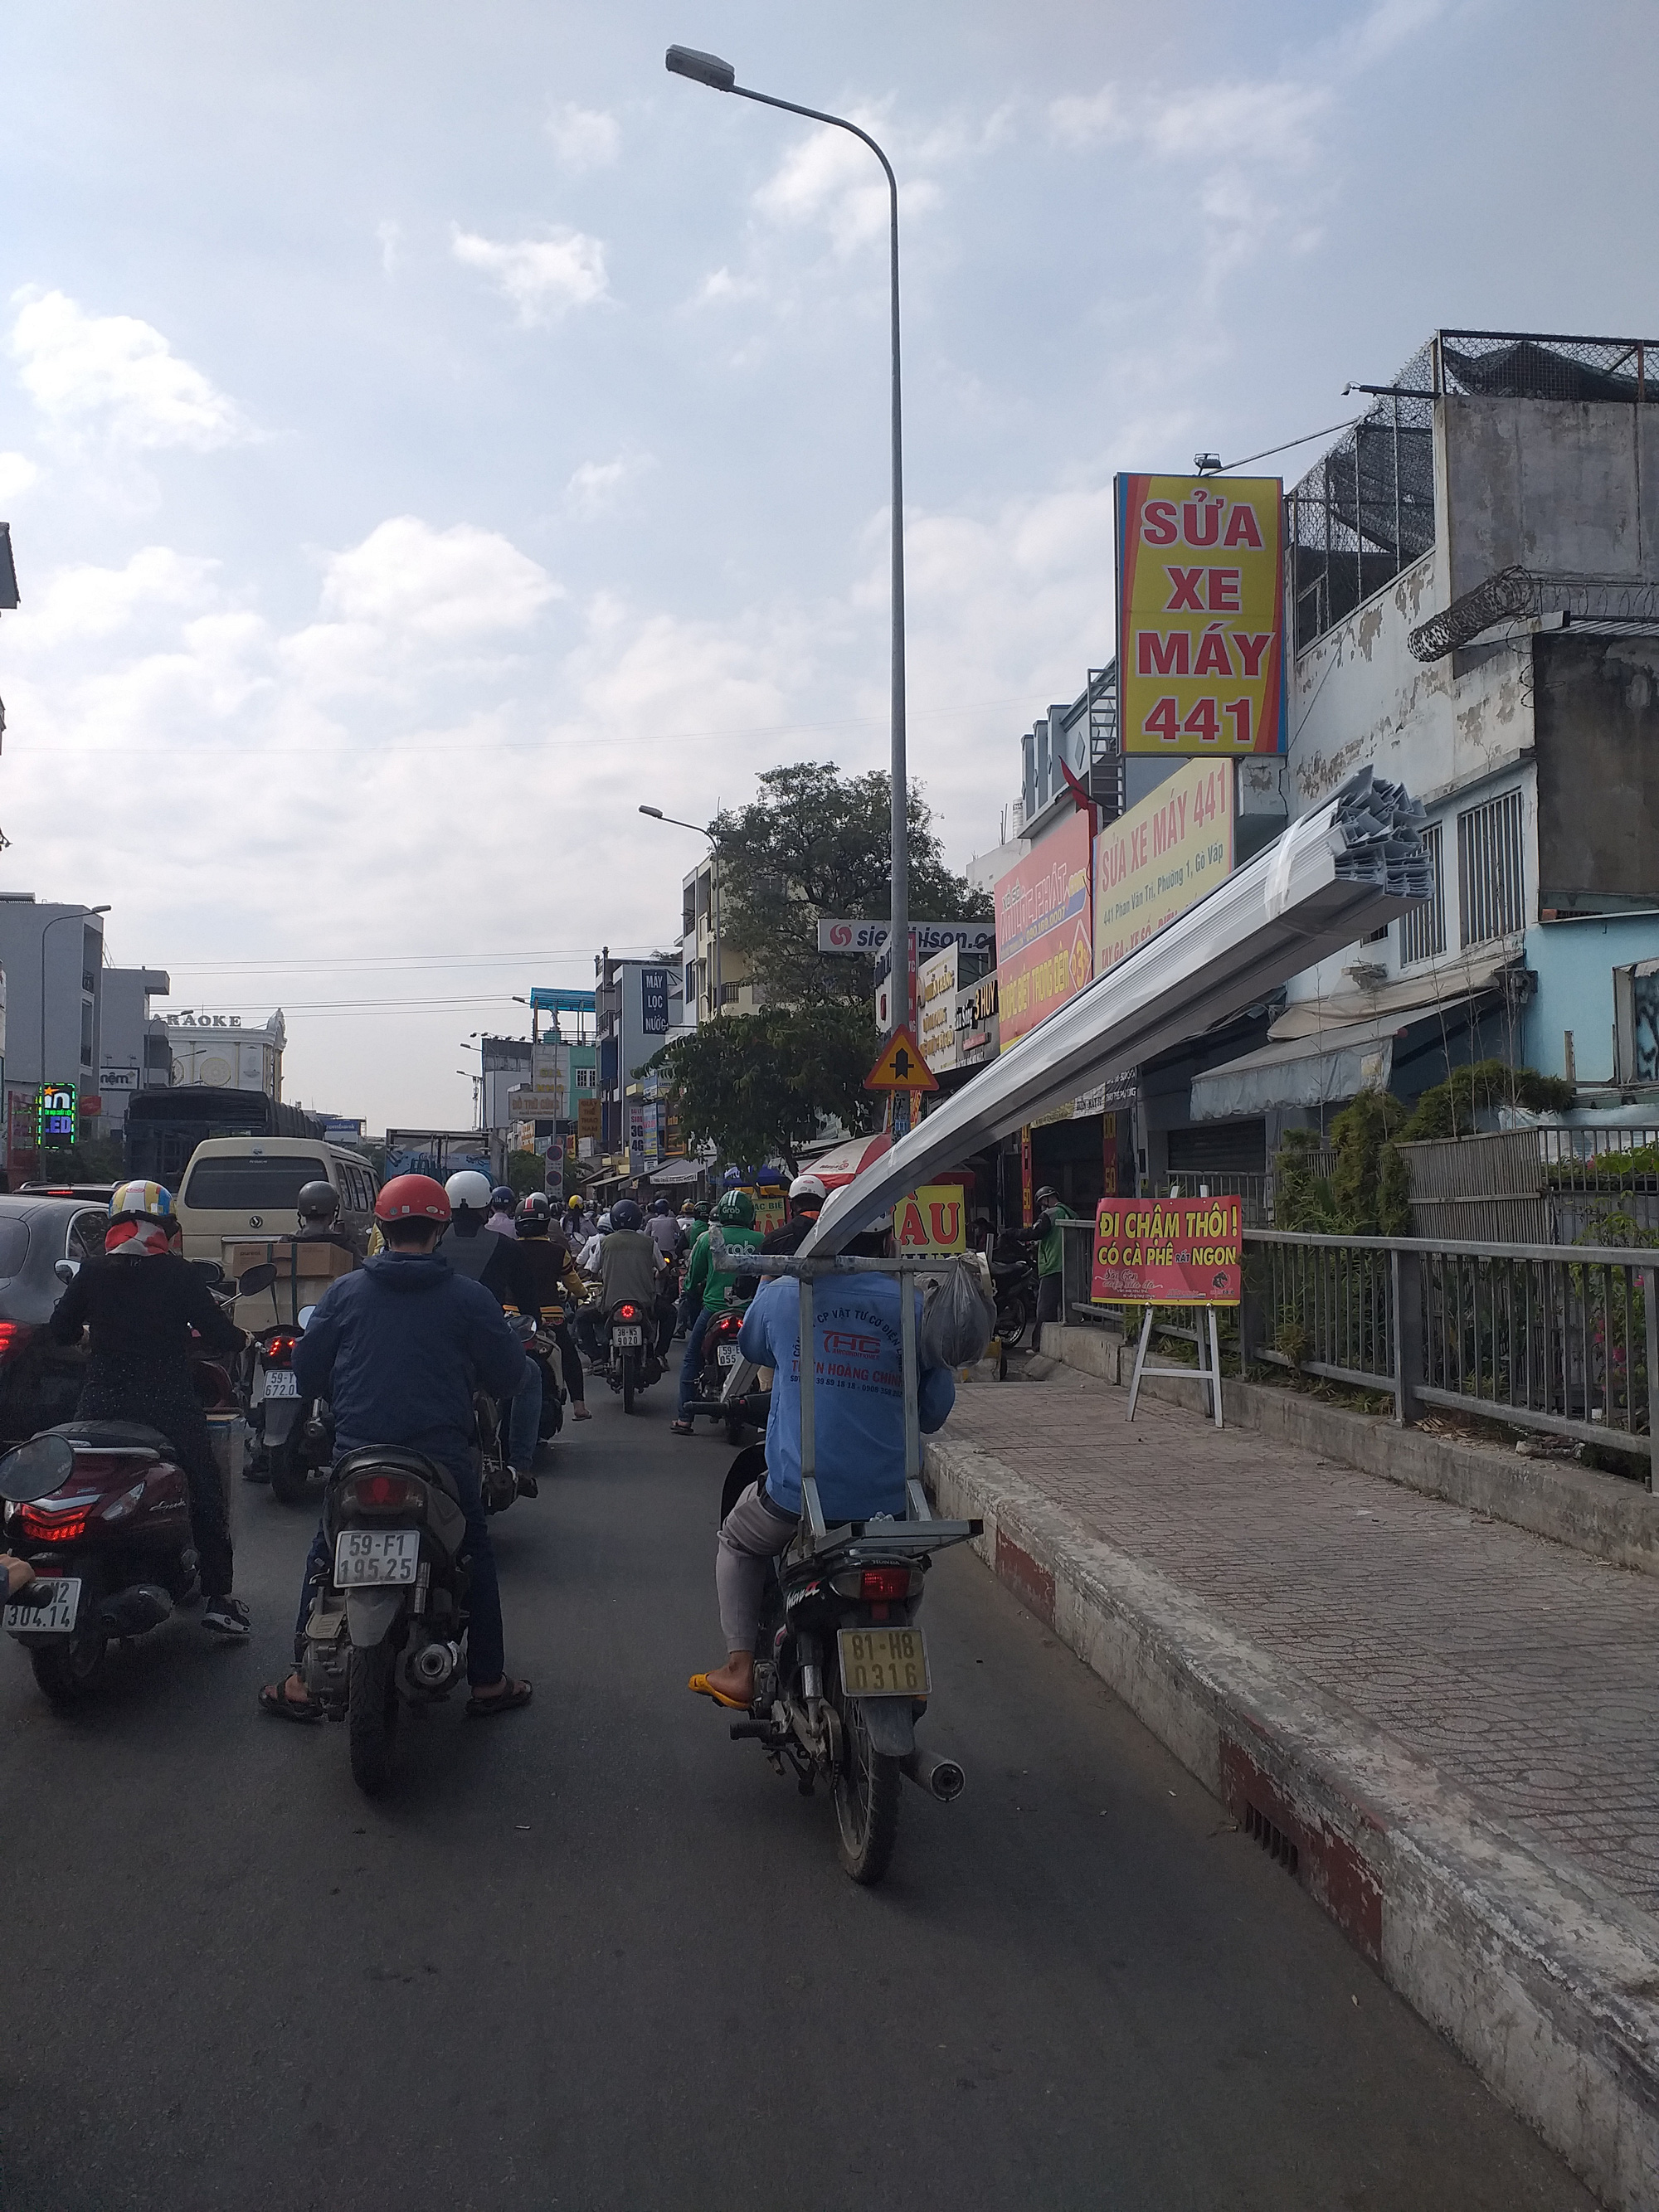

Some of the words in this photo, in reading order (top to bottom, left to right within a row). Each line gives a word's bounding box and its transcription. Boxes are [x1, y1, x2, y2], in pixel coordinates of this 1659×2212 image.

[1142, 489, 1263, 548] SỬA
[1165, 567, 1242, 611] XE
[1137, 622, 1272, 677] MÁY
[1144, 697, 1253, 741] 441
[1102, 832, 1127, 892] SỬA
[1131, 820, 1148, 873] XE
[1153, 788, 1188, 858] MÁY
[1194, 762, 1226, 828] 441
[1103, 910, 1114, 926] 441
[1116, 899, 1130, 919] Phan
[1131, 890, 1144, 910] Văn
[1195, 851, 1205, 873] Gò
[1207, 839, 1224, 864] Vấp
[1102, 946, 1113, 970] TAY
[1114, 942, 1124, 962] GA
[645, 973, 663, 989] MÁY
[647, 999, 663, 1011] LỌC
[974, 989, 980, 1020] 3
[980, 980, 996, 1018] HUY
[631, 1125, 644, 1137] 3G
[632, 1140, 644, 1151] 4G
[1100, 1212, 1119, 1238] ĐI
[1125, 1204, 1180, 1246] CHẬM
[1185, 1203, 1227, 1238] THÔI
[726, 1241, 756, 1255] rab
[1098, 1242, 1119, 1266] CÓ
[1122, 1242, 1142, 1266] CÀ
[1146, 1242, 1173, 1266] PHÊ
[1192, 1247, 1236, 1266] NGON
[817, 1312, 829, 1324] CP
[832, 1307, 850, 1320] VẬT
[855, 1309, 868, 1320] TƯ
[869, 1315, 884, 1327] CƠ
[882, 1324, 901, 1347] ĐIỆN
[617, 1336, 638, 1345] 9020
[722, 1346, 741, 1355] 59-E
[720, 1355, 737, 1364] 055
[271, 1372, 294, 1383] 59-Y
[828, 1363, 868, 1381] HOÀNG
[265, 1384, 295, 1397] 672.0
[837, 1379, 844, 1388] 18
[847, 1381, 855, 1389] 18
[349, 1534, 405, 1557] 59-F1
